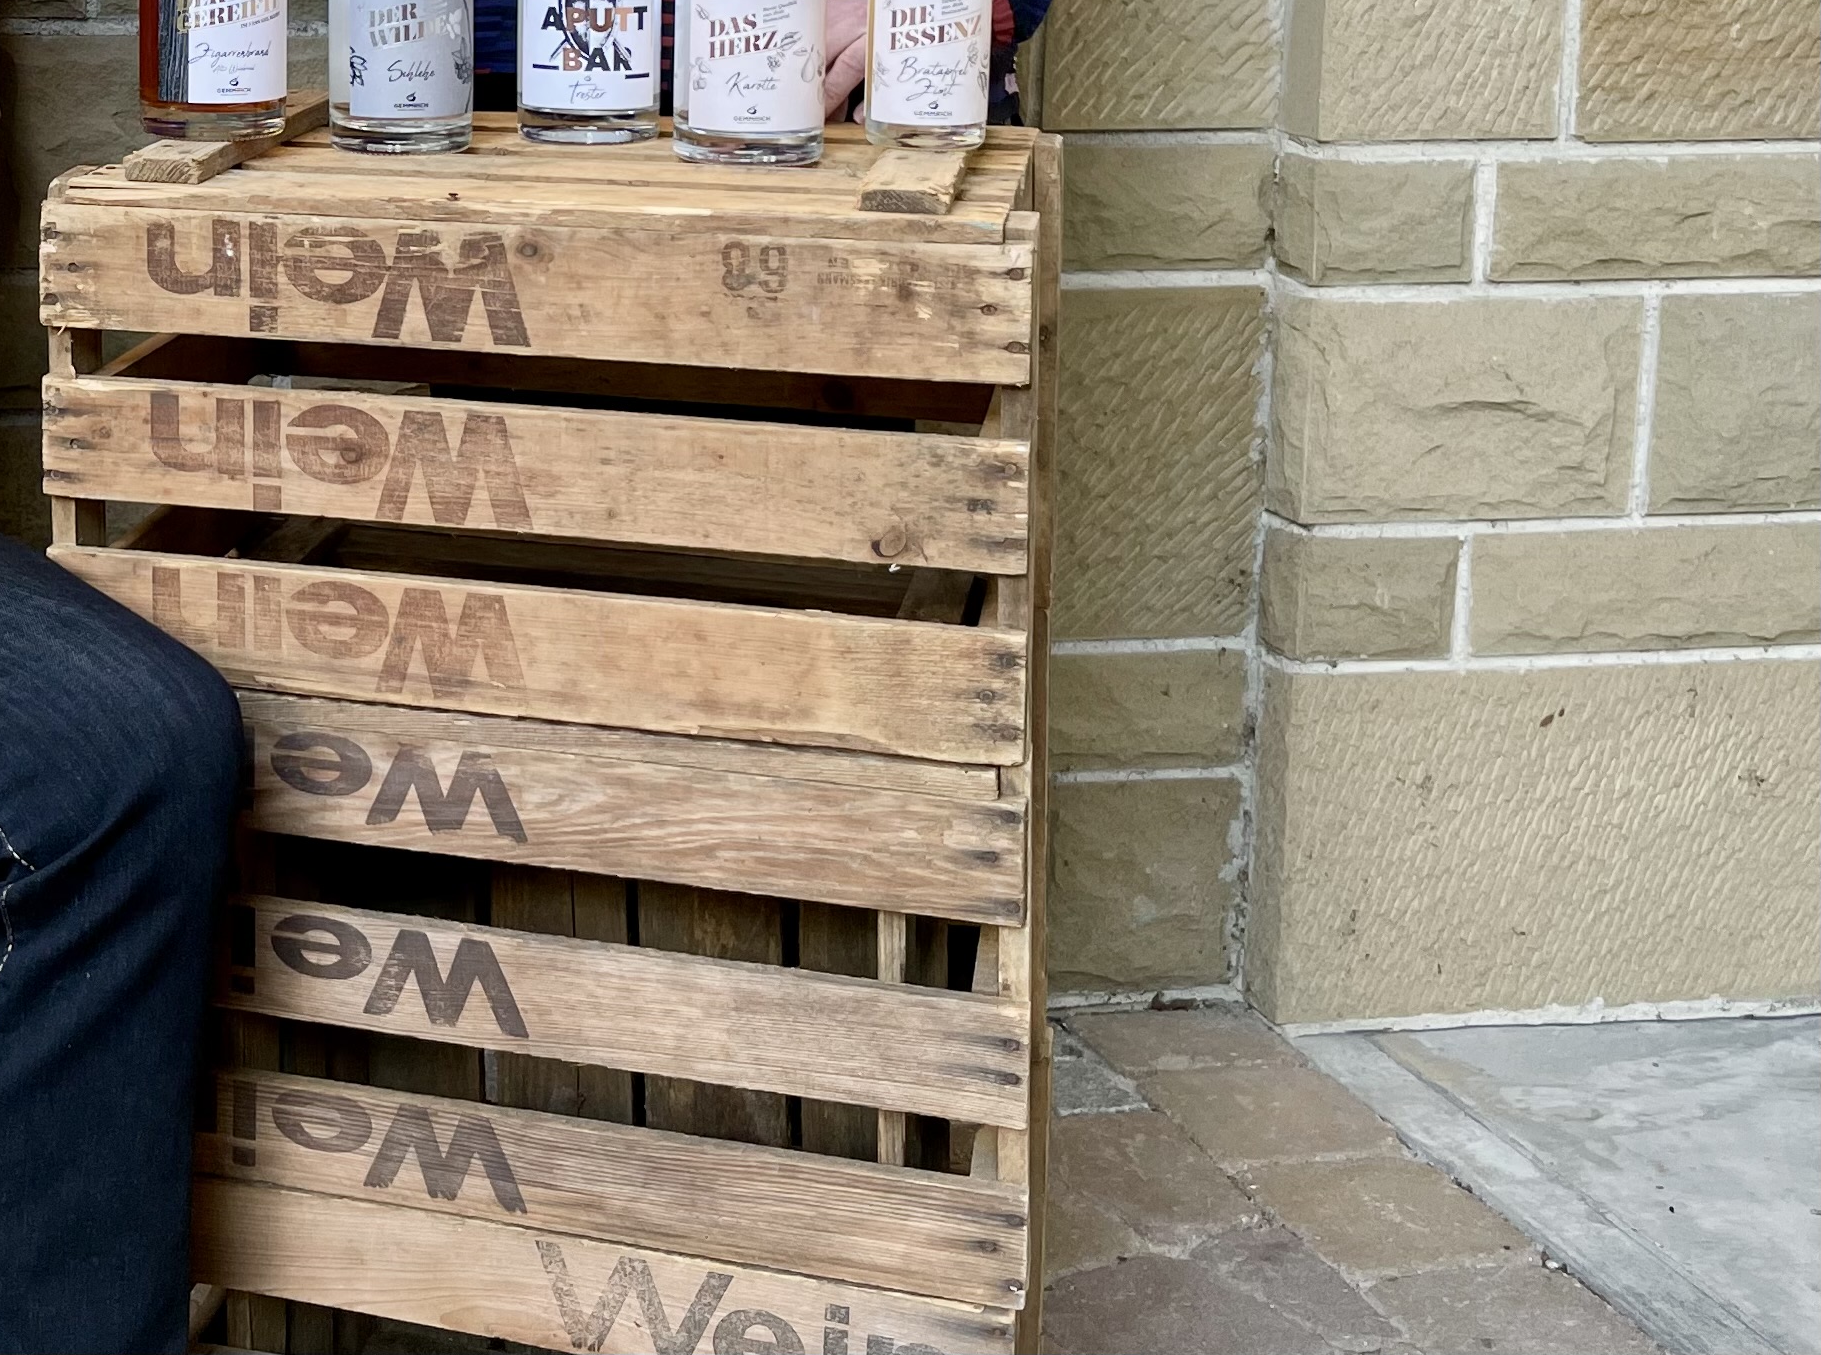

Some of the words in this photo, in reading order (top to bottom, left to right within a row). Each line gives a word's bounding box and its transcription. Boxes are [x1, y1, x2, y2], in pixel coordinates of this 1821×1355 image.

[368, 2, 418, 29] DER
[540, 6, 648, 32] APUTT
[709, 12, 758, 38] DAS
[890, 3, 935, 29] DIE
[708, 29, 779, 60] HERZ
[889, 13, 982, 51] ESSENZ
[387, 59, 436, 83] Schlehe
[562, 47, 633, 72] BAR
[897, 56, 971, 83] Bratapfel
[569, 80, 608, 105] Trester
[725, 71, 781, 98] Karotte
[146, 218, 532, 348] Wein
[150, 392, 533, 531] Wein
[151, 565, 528, 702] Wein
[244, 724, 529, 844] We
[230, 904, 530, 1038] Wei
[194, 1076, 529, 1215] Wei
[535, 1240, 948, 1355] Wei
